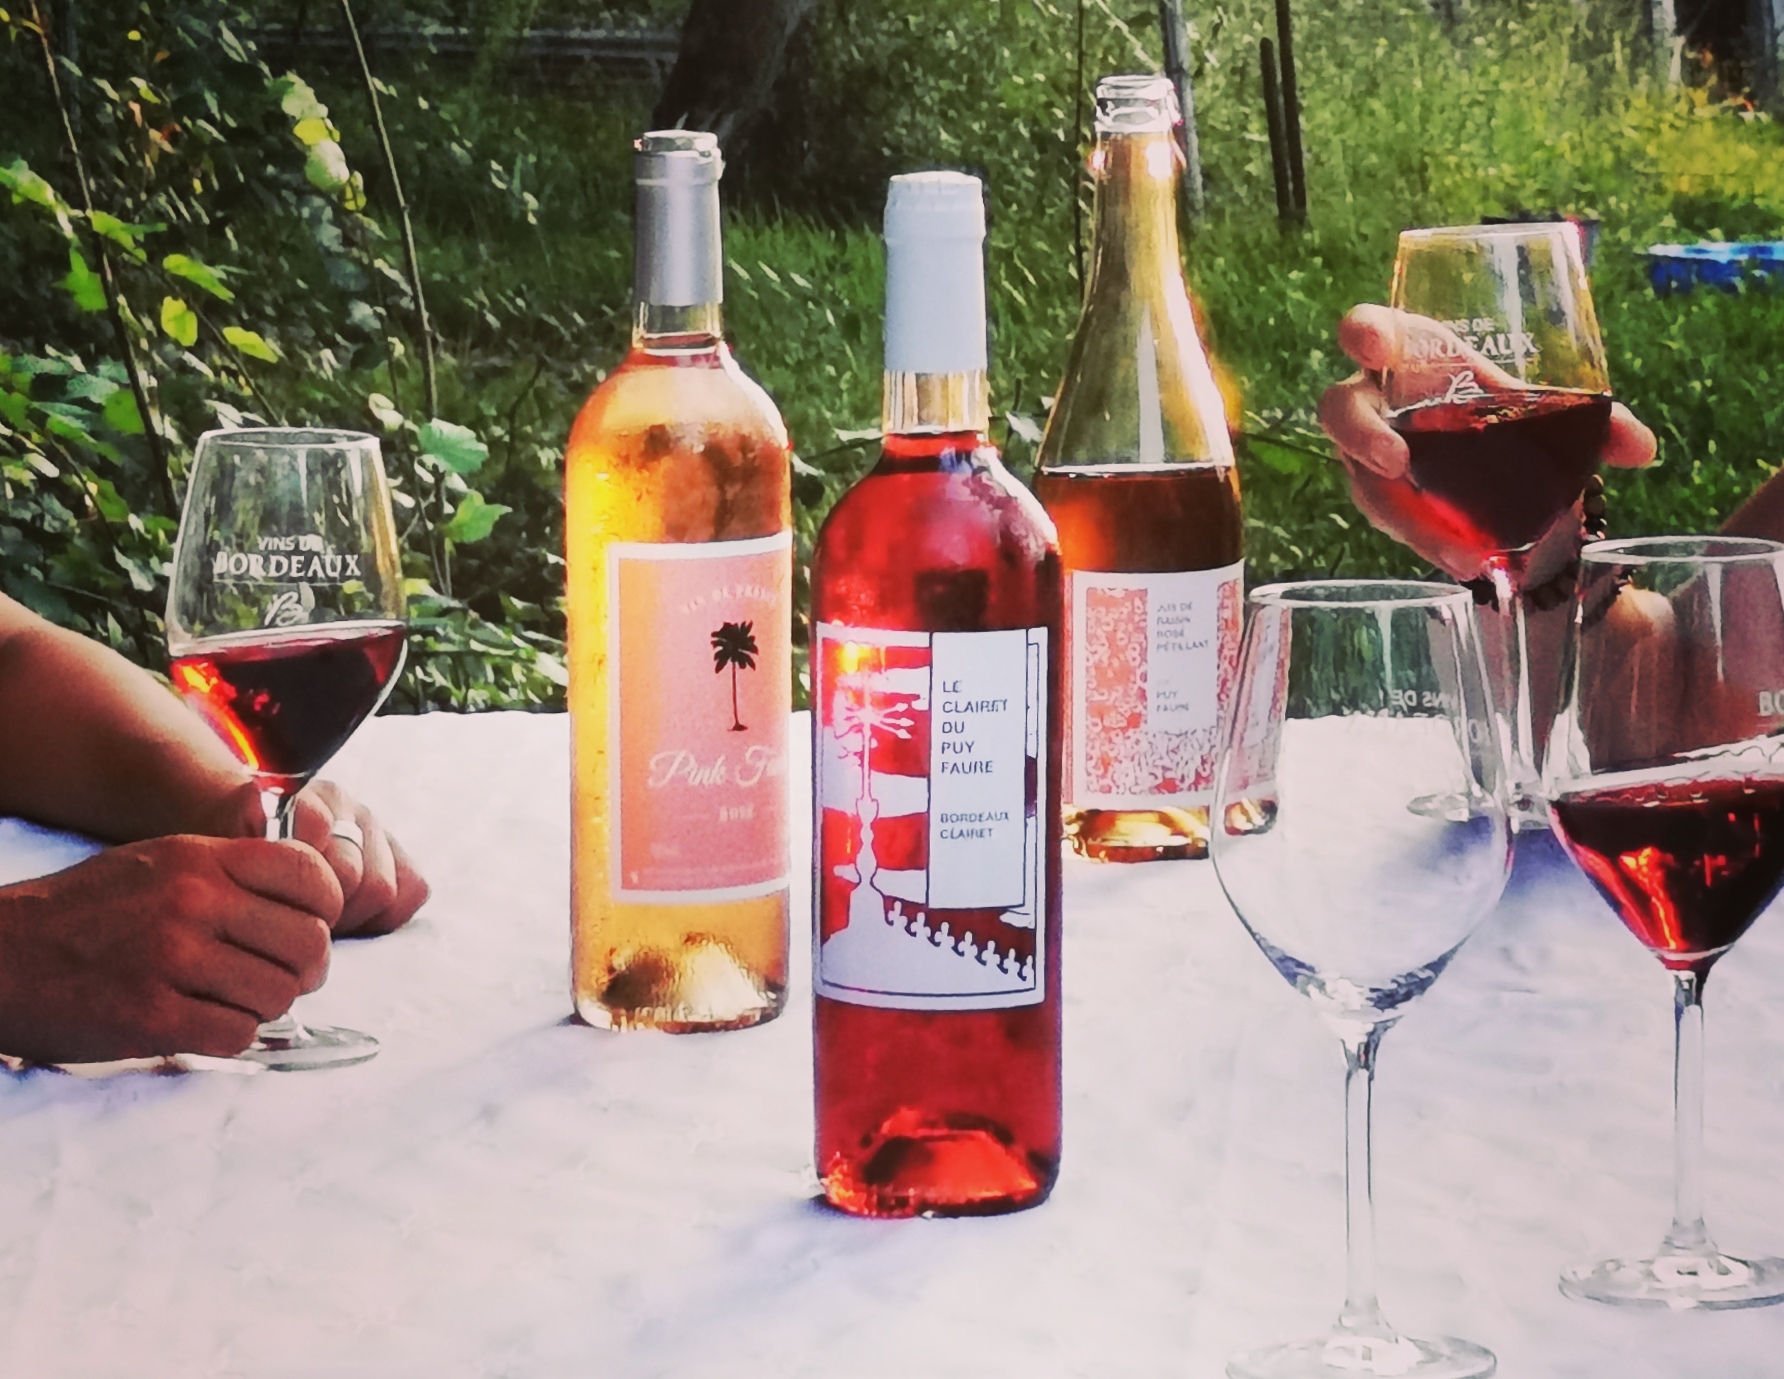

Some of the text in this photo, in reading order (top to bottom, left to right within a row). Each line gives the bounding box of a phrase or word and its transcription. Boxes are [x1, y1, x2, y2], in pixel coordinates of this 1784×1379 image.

[1472, 317, 1496, 332] DE
[257, 535, 296, 552] VINS
[212, 551, 361, 580] BORDEAUX
[942, 680, 963, 694] LE
[942, 699, 1008, 714] CLAIRET
[941, 721, 966, 734] DU
[941, 741, 976, 755] PUY
[646, 750, 727, 788] Pink
[941, 761, 994, 775] FAURE
[940, 812, 1010, 824] BORDEAUX
[940, 827, 994, 841] CLAIRET
